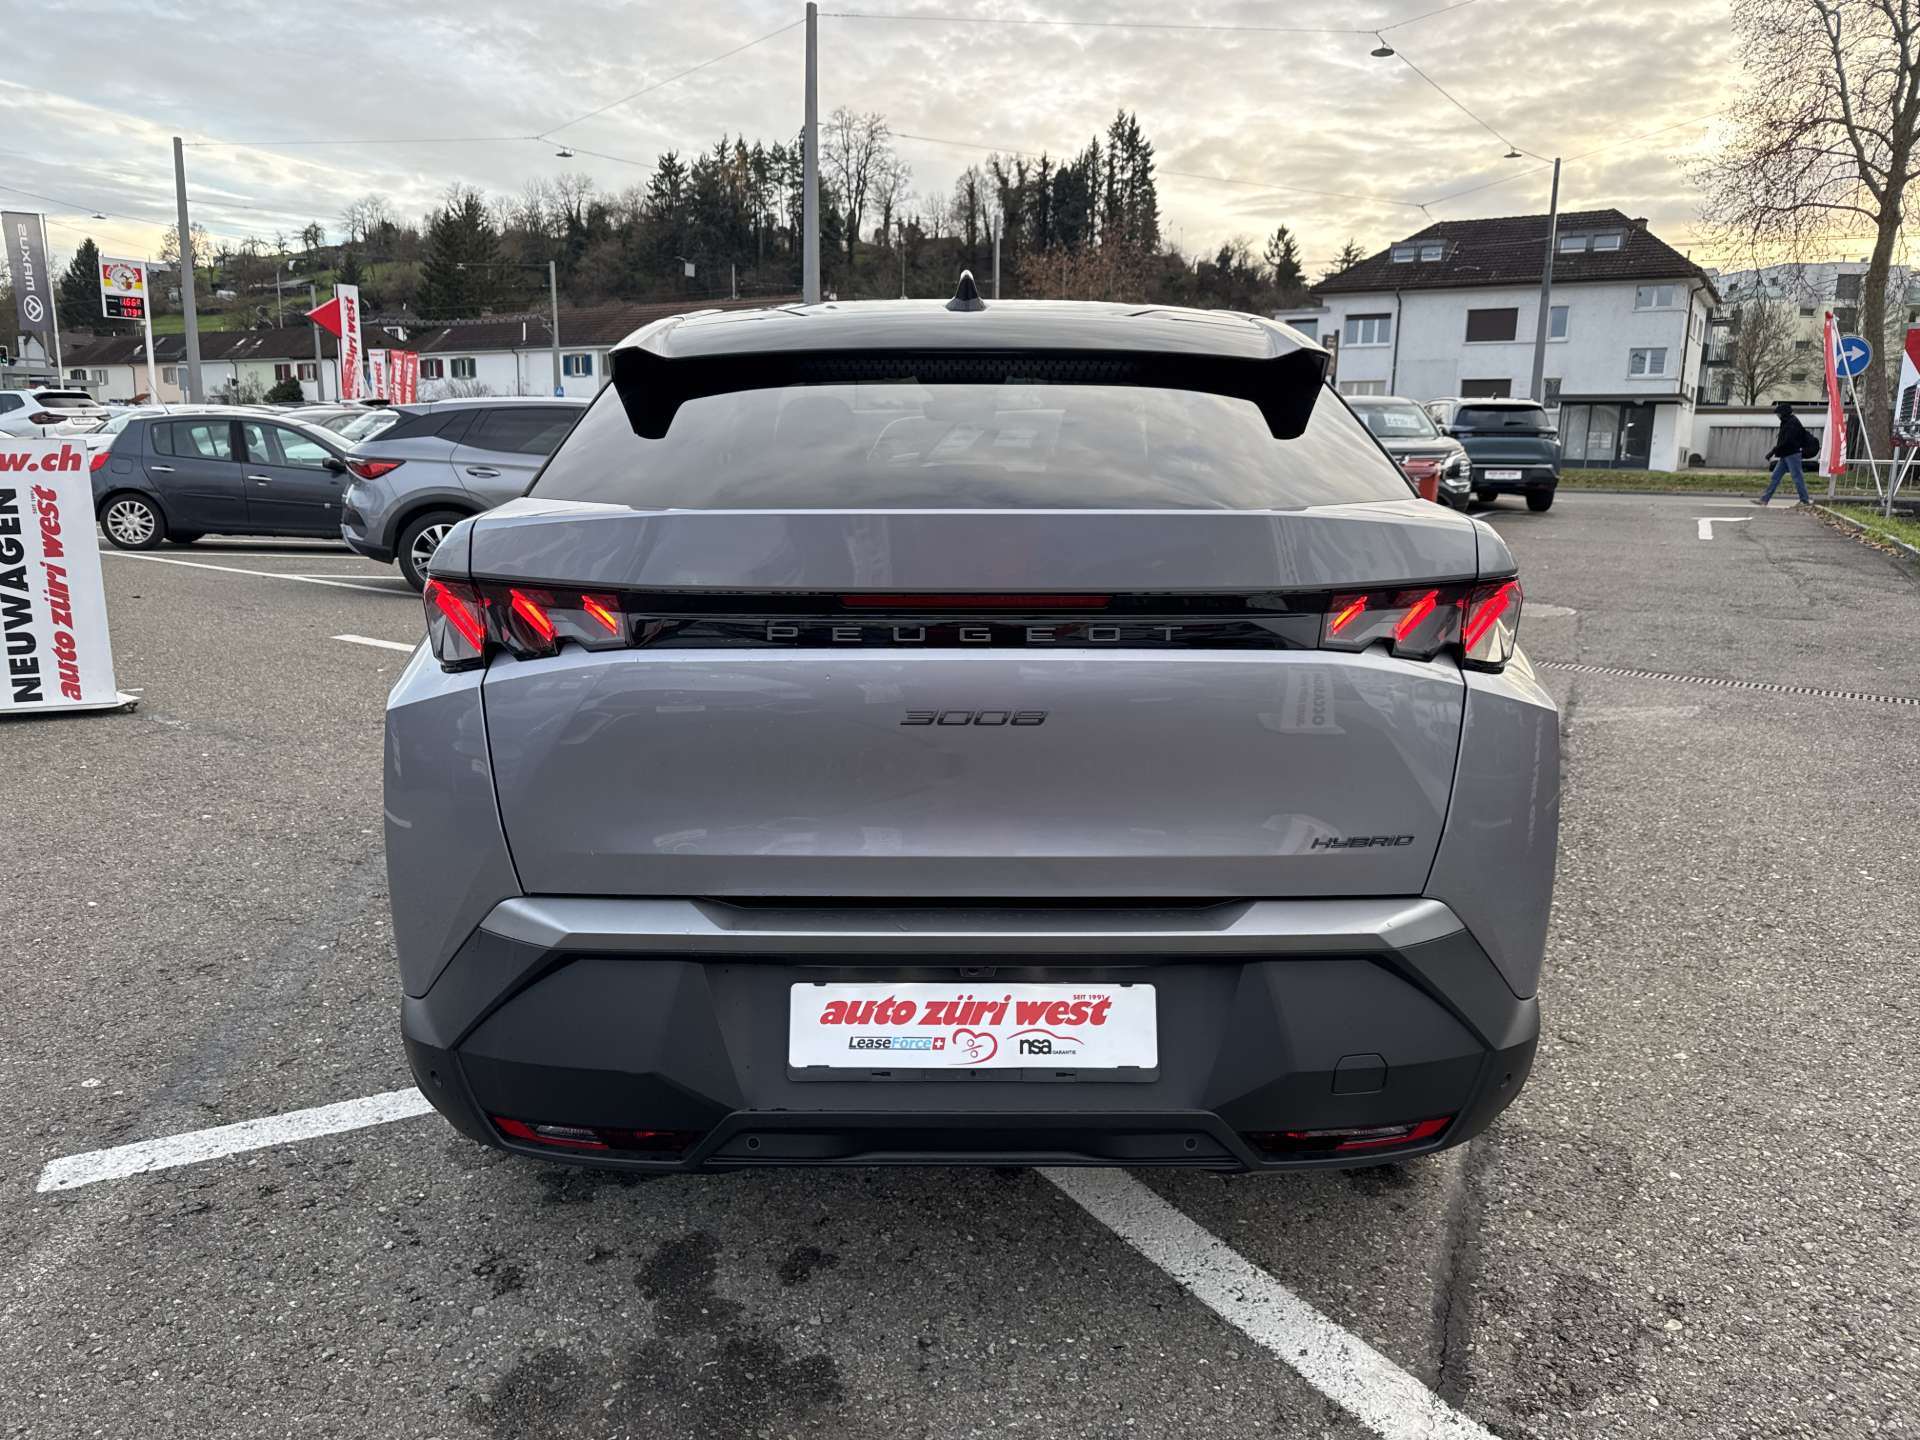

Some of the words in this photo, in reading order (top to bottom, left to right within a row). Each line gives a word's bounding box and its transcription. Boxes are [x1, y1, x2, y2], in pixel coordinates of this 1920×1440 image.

[345, 295, 356, 334] west
[31, 484, 64, 558] west
[0, 488, 43, 702] NEUWAGEN
[40, 561, 73, 630] züri
[766, 626, 1184, 642] PEUGEOT
[52, 630, 82, 701] auto
[900, 711, 1049, 726] 3008
[1311, 835, 1415, 849] HYBRID
[819, 995, 917, 1025] auto
[918, 994, 1012, 1026] züri
[1015, 995, 1112, 1026] west
[848, 1036, 932, 1050] LeaseForce
[1019, 1039, 1052, 1055] nsa
